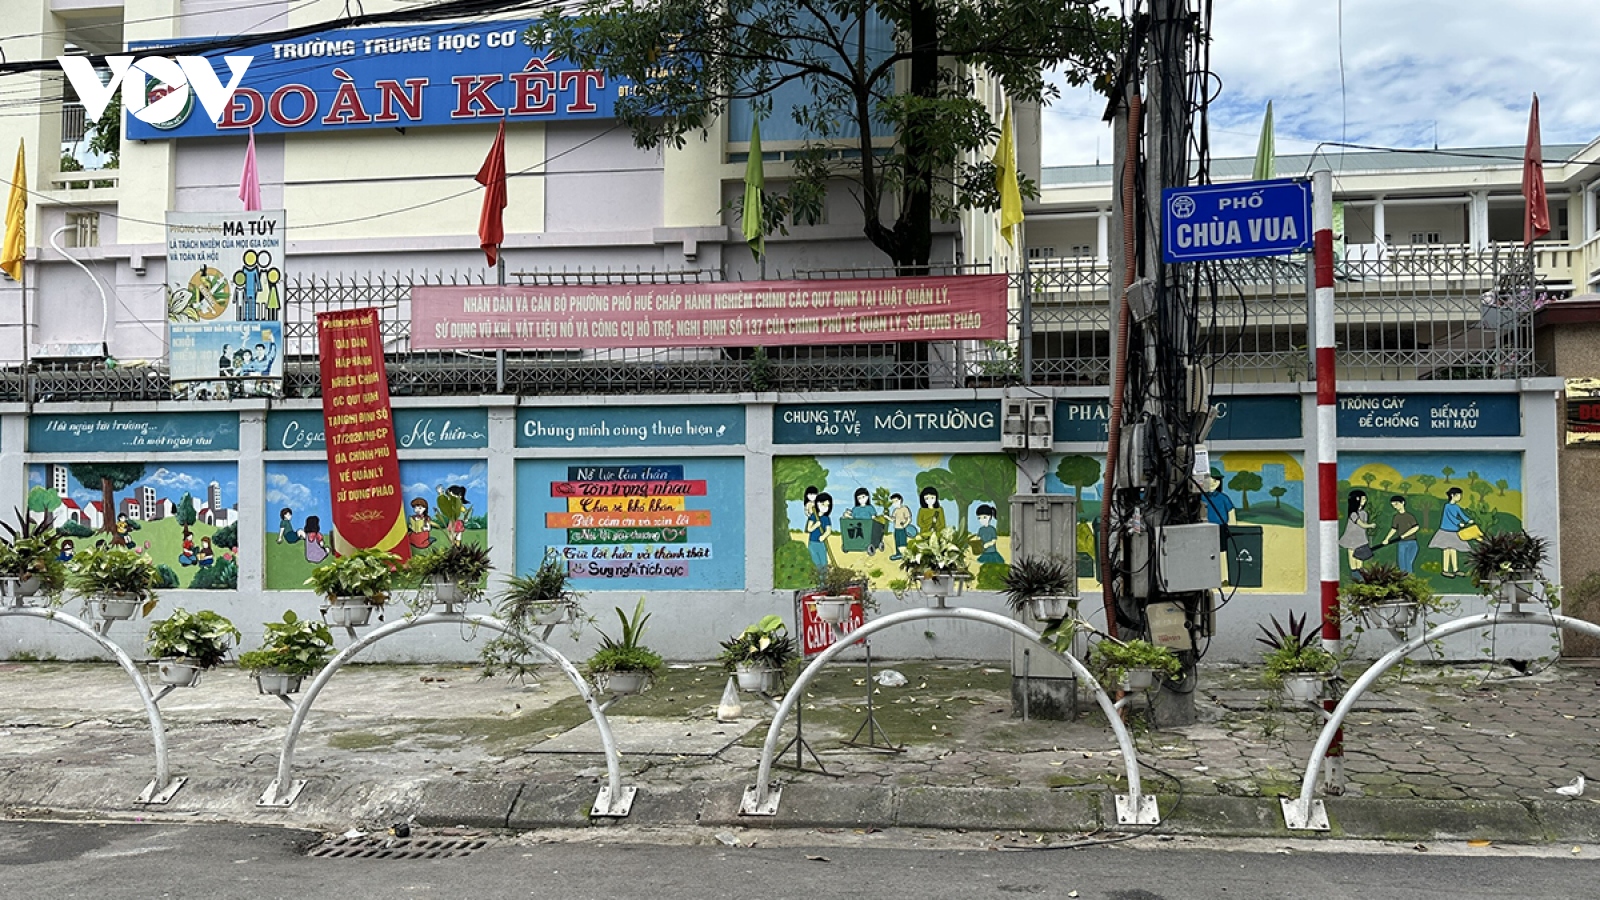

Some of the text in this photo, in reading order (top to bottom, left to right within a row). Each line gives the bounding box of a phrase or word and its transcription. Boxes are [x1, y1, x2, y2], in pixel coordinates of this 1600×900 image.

[271, 29, 517, 60] TRƯỜNG TRUNG HỌC CƠ
[216, 50, 606, 129] ĐOÀN KẾT
[1218, 189, 1265, 211] PHỐ
[223, 221, 245, 236] MA
[248, 215, 277, 236] TÚY
[1176, 215, 1298, 249] CHÙA VUA
[178, 238, 198, 249] TRÁCH
[221, 238, 234, 249] CỦA
[249, 239, 261, 249] GIA
[463, 292, 491, 313] NHÂN
[492, 292, 514, 313] DÂN
[515, 291, 529, 312] VÀ
[531, 291, 551, 313] CÁN
[553, 291, 567, 316] BỘ
[570, 289, 609, 313] PHƯỜNG
[611, 289, 632, 312] PHỐ
[634, 289, 654, 311] HUẾ
[656, 289, 681, 311] CHẤP
[685, 288, 712, 311] HÀNH
[714, 289, 753, 310] NGHIÊM
[755, 287, 787, 309] CHỈNH
[788, 288, 810, 309] CÁC
[811, 290, 832, 309] QUY
[833, 290, 858, 311] ĐỊNH
[859, 289, 875, 309] TẠI
[878, 287, 904, 309] LUẬT
[904, 284, 933, 306] QUẢN
[435, 318, 450, 339] SỬ
[451, 321, 477, 341] DỤNG
[478, 319, 493, 338] VŨ
[515, 320, 535, 341] VẬT
[536, 319, 558, 342] LIỆU
[559, 316, 574, 338] NỔ
[575, 318, 590, 338] VÀ
[591, 318, 619, 338] CÔNG
[621, 319, 635, 341] CỤ
[636, 314, 651, 337] HỖ
[676, 318, 701, 340] NGHỊ
[703, 319, 727, 340] ĐỊNH
[728, 313, 743, 336] SỐ
[745, 319, 763, 336] 137
[765, 315, 786, 335] CỦA
[788, 313, 820, 334] CHÍNH
[821, 313, 842, 334] PHỦ
[844, 312, 858, 333] VỀ
[859, 311, 887, 334] QUẢN
[907, 311, 922, 331] SỬ
[923, 313, 952, 334] DỤNG
[954, 311, 982, 330] PHÁO
[1339, 395, 1380, 411] TRỒNG
[1430, 401, 1480, 419] BIẾN ĐỔI
[783, 406, 995, 431] CHUNG TAY MÔI TRƯỜNG
[815, 420, 861, 437] BẢO VỆ
[1359, 410, 1420, 428] ĐỂ CHỐNG
[1431, 415, 1478, 430] KHÍ HẬU
[281, 420, 305, 449] Cô
[523, 419, 575, 441] Chúng
[612, 423, 648, 441] cùng
[651, 419, 683, 438] thực
[686, 419, 713, 437] hiện
[579, 480, 692, 498] Tôn trọng nhau
[588, 561, 614, 578] Suy
[639, 561, 662, 576] tích
[663, 565, 685, 578] cực
